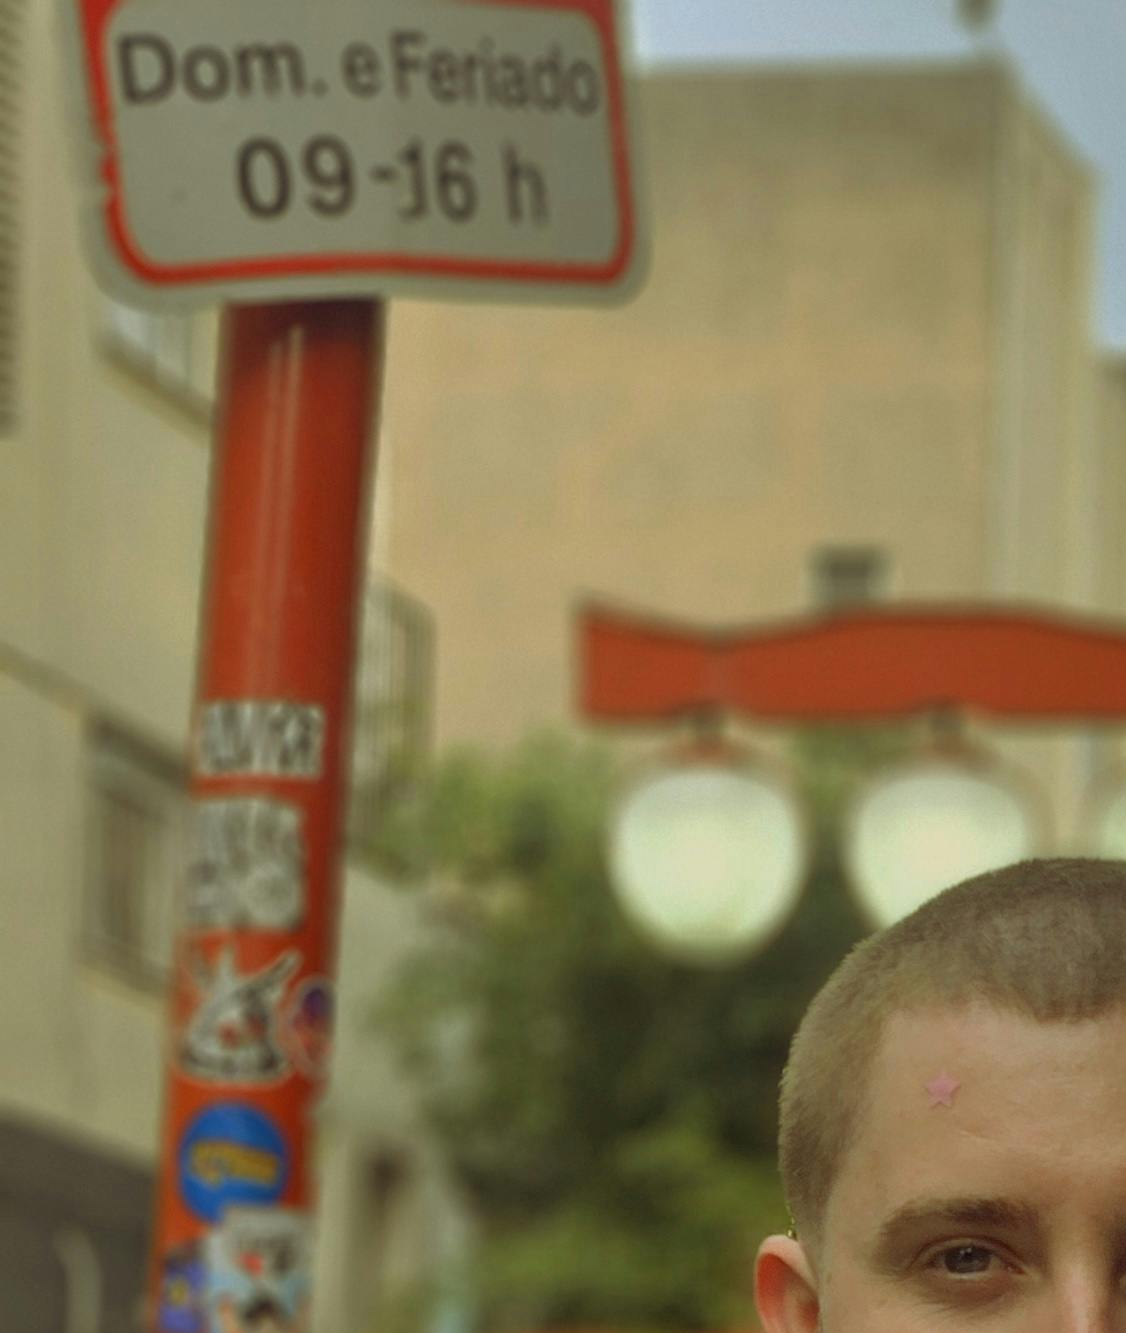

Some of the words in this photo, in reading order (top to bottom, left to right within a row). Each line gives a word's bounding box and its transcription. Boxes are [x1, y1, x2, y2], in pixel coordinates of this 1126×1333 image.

[117, 32, 328, 104] Dom.
[340, 41, 382, 100] e
[391, 28, 602, 118] Feriado
[503, 138, 552, 227] h
